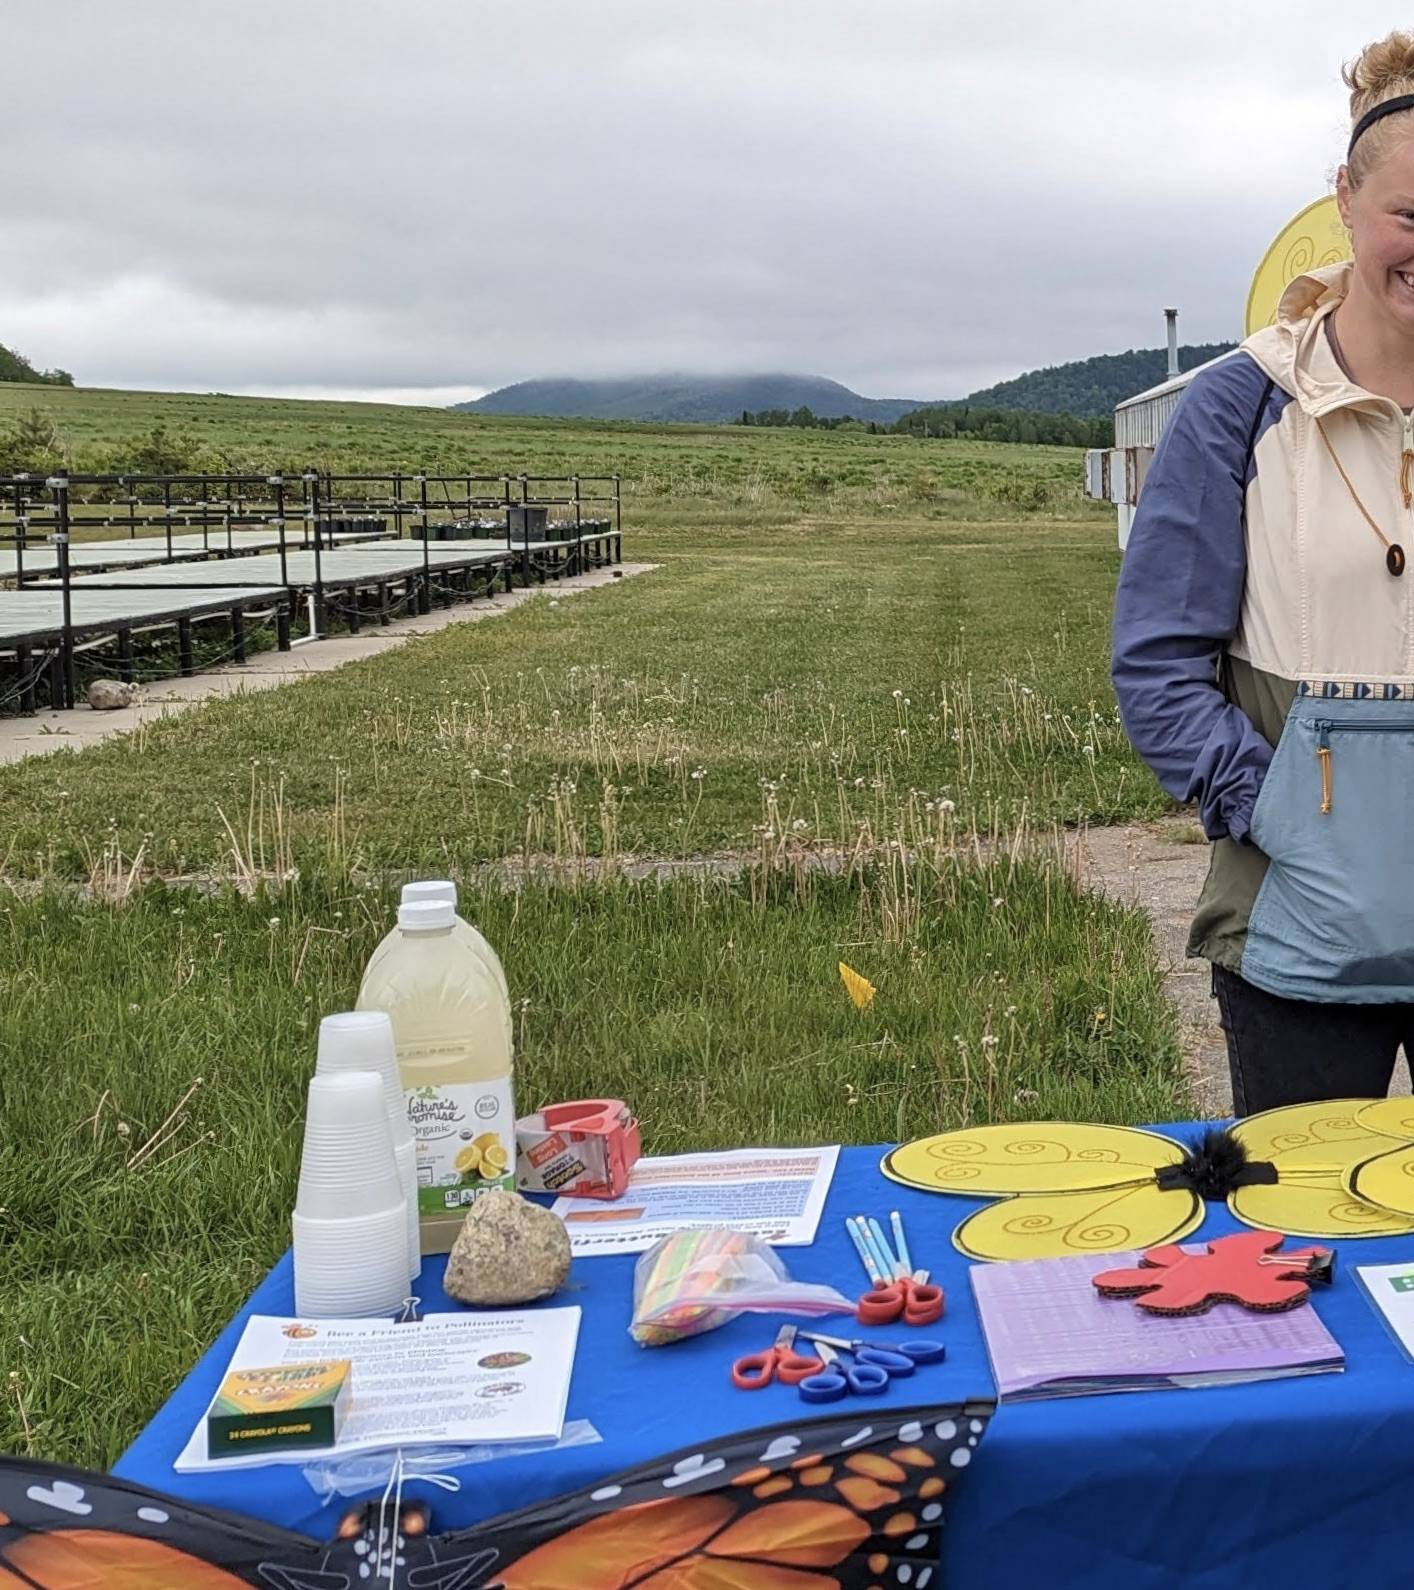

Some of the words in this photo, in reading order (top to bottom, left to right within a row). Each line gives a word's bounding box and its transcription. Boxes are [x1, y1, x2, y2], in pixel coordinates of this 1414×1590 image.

[407, 1112, 466, 1124] romise
[541, 1154, 575, 1180] STORAGE
[545, 1162, 583, 1189] Scotch
[571, 1232, 668, 1247] Butterfl
[371, 1326, 421, 1336] Friend
[444, 1319, 525, 1329] Pollinators
[277, 1423, 312, 1435] CRAYONS
